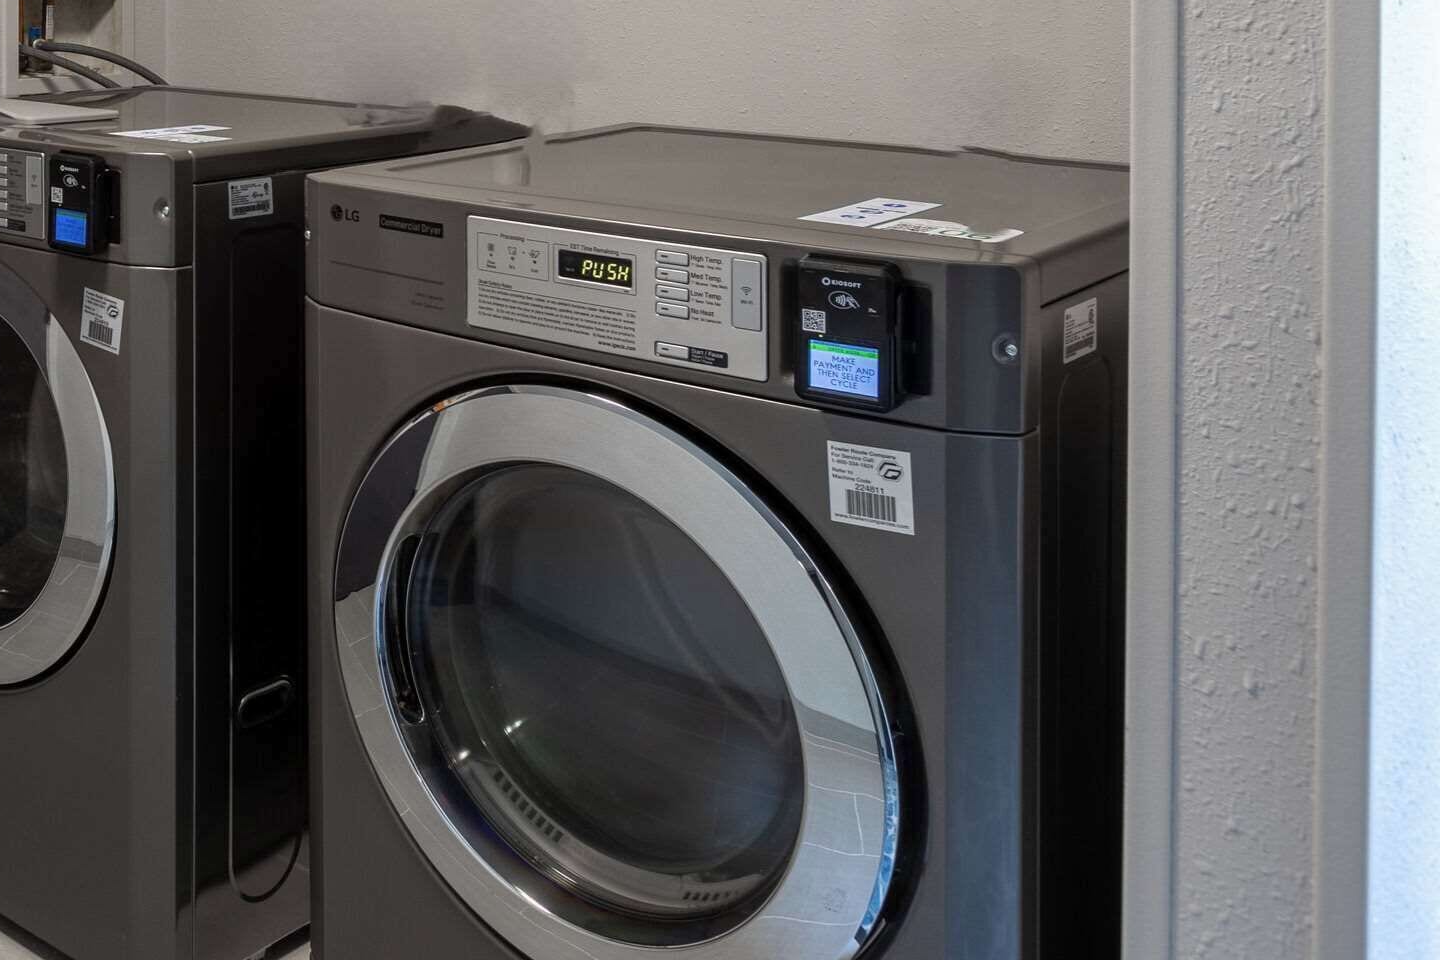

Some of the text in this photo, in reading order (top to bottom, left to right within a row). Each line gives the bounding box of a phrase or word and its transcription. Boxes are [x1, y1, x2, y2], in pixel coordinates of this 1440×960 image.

[380, 216, 442, 236] Commercial Dryer
[690, 255, 704, 263] High
[581, 259, 630, 281] PUSH
[690, 272, 704, 280] Med
[831, 279, 862, 289] KIOSOFT
[690, 289, 704, 297] Low
[831, 355, 856, 366] MAKE
[814, 360, 875, 377] PAYMENT AND
[817, 368, 872, 385] THEN SELECT
[830, 377, 858, 390] CYCLE
